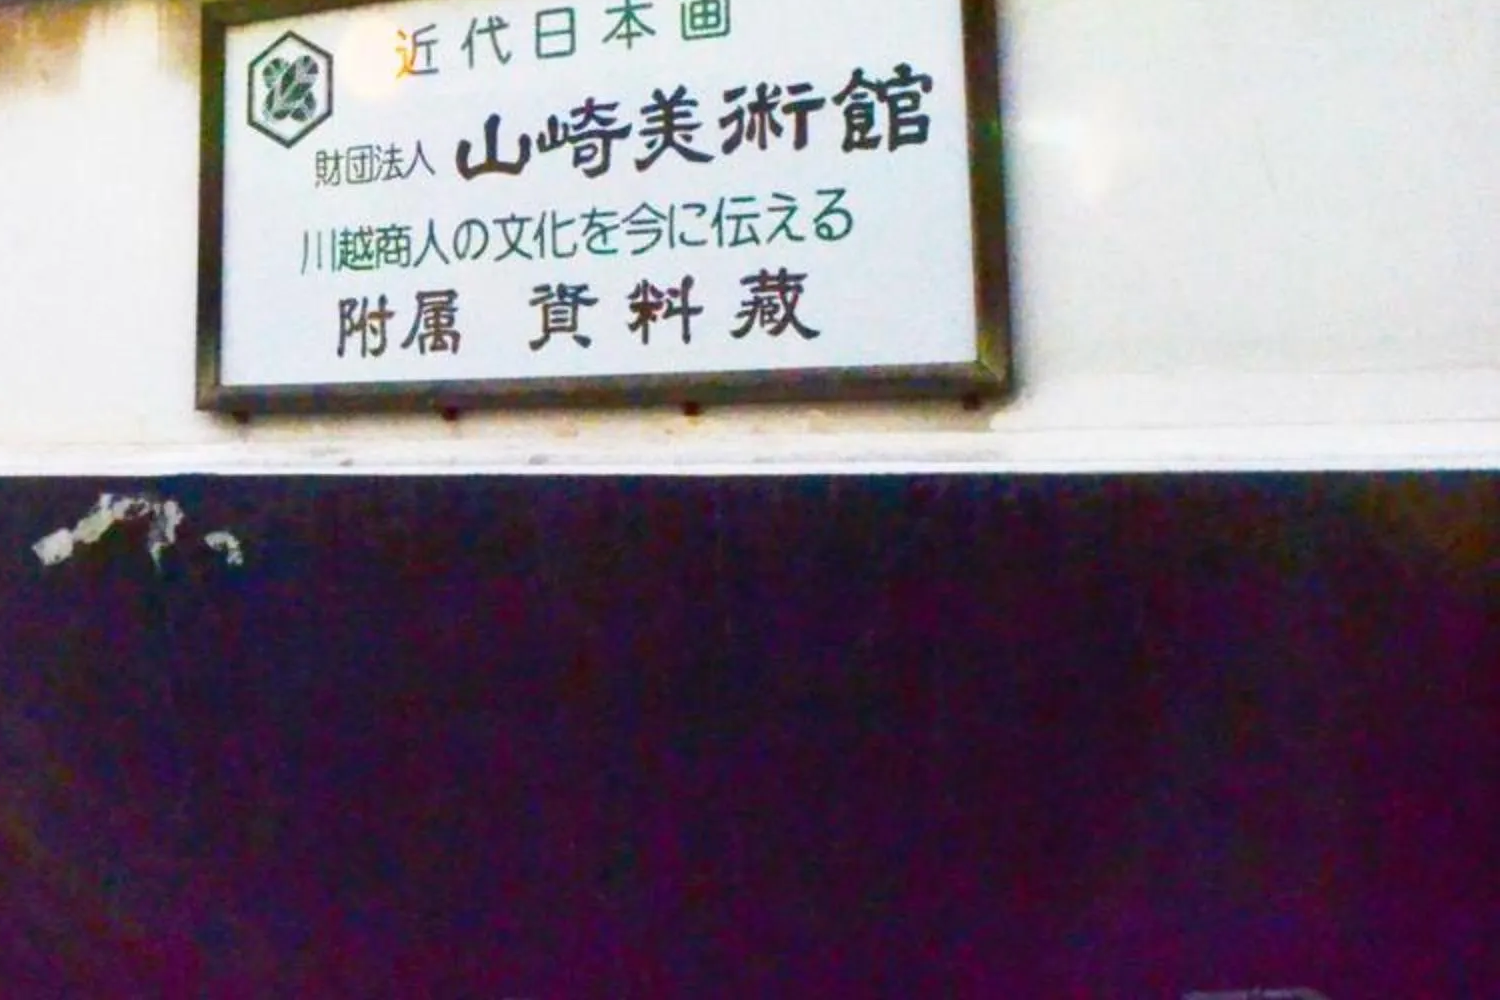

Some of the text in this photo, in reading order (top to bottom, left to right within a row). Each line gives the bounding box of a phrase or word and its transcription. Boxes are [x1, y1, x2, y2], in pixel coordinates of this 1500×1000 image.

[314, 62, 933, 187] 財団法人 山崎美術館
[301, 187, 854, 274] 川越商人の文化を今に伝える
[336, 267, 820, 358] 附属 資料蔵
